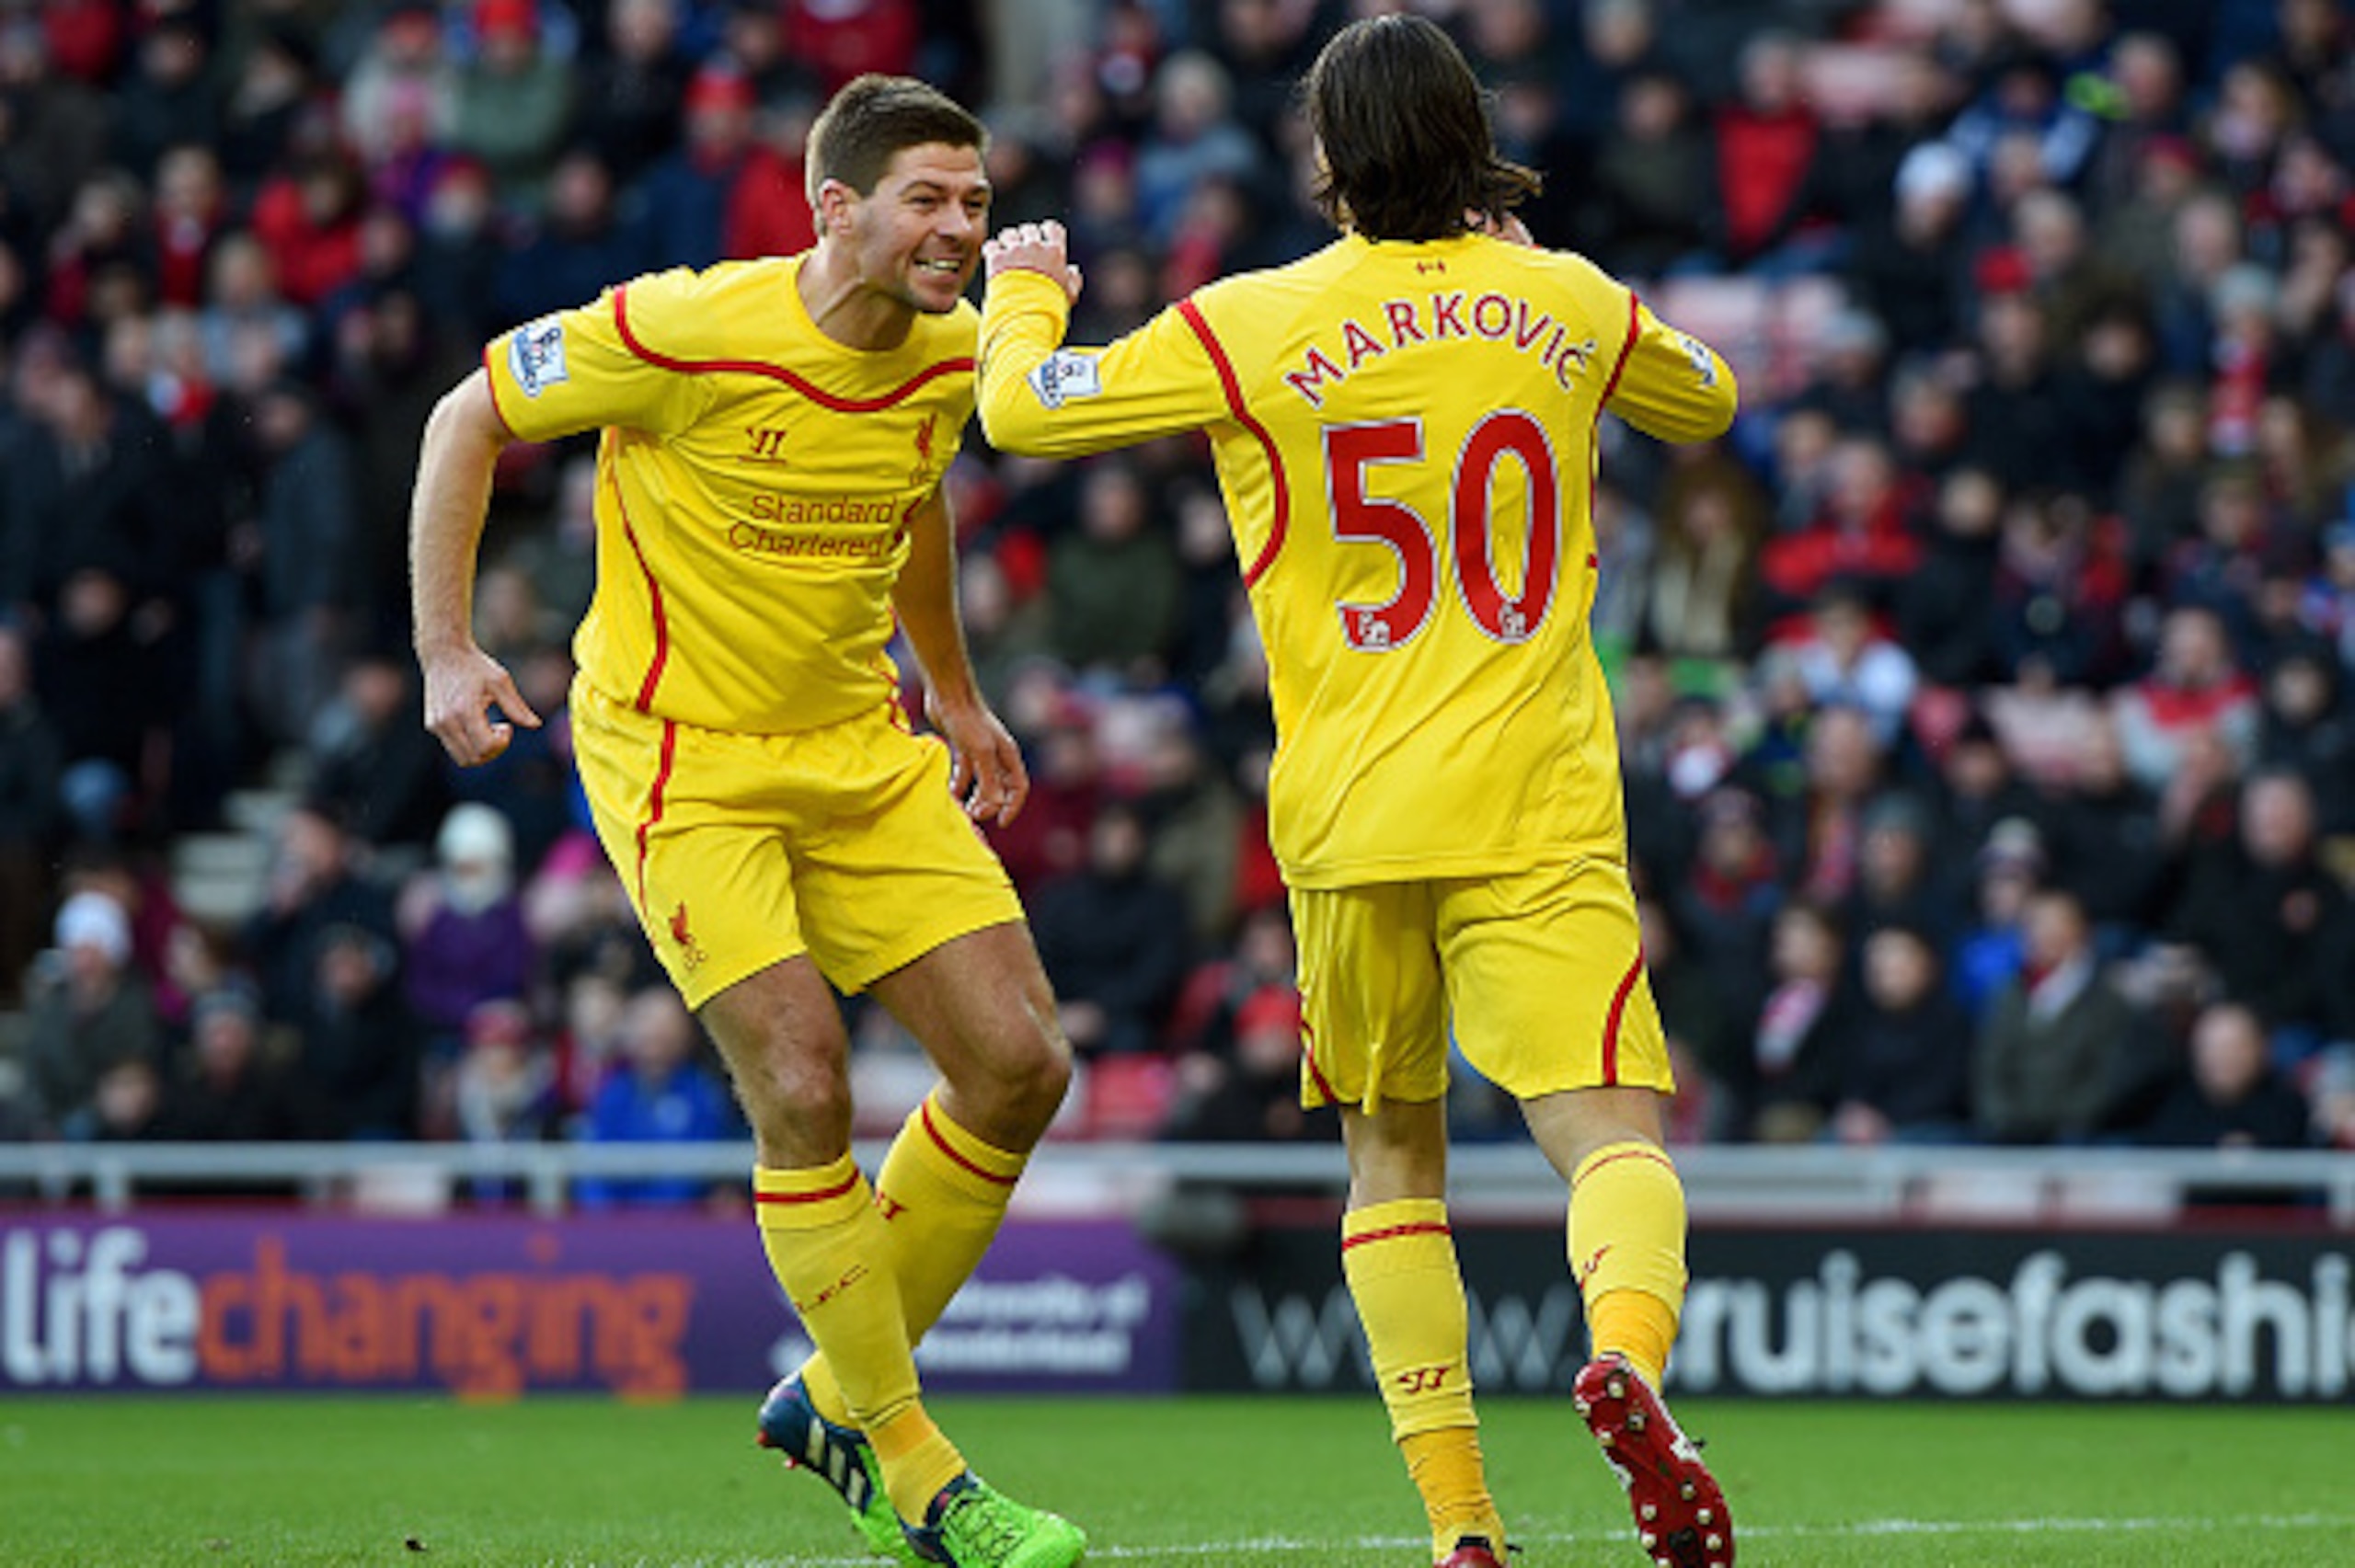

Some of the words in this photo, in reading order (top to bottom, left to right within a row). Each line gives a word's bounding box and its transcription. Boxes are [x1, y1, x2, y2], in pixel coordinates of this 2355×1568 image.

[1284, 294, 1596, 409] MARKOVIĆ
[729, 521, 884, 558] Chartered
[751, 494, 897, 524] Standard
[1321, 407, 1560, 652] 50
